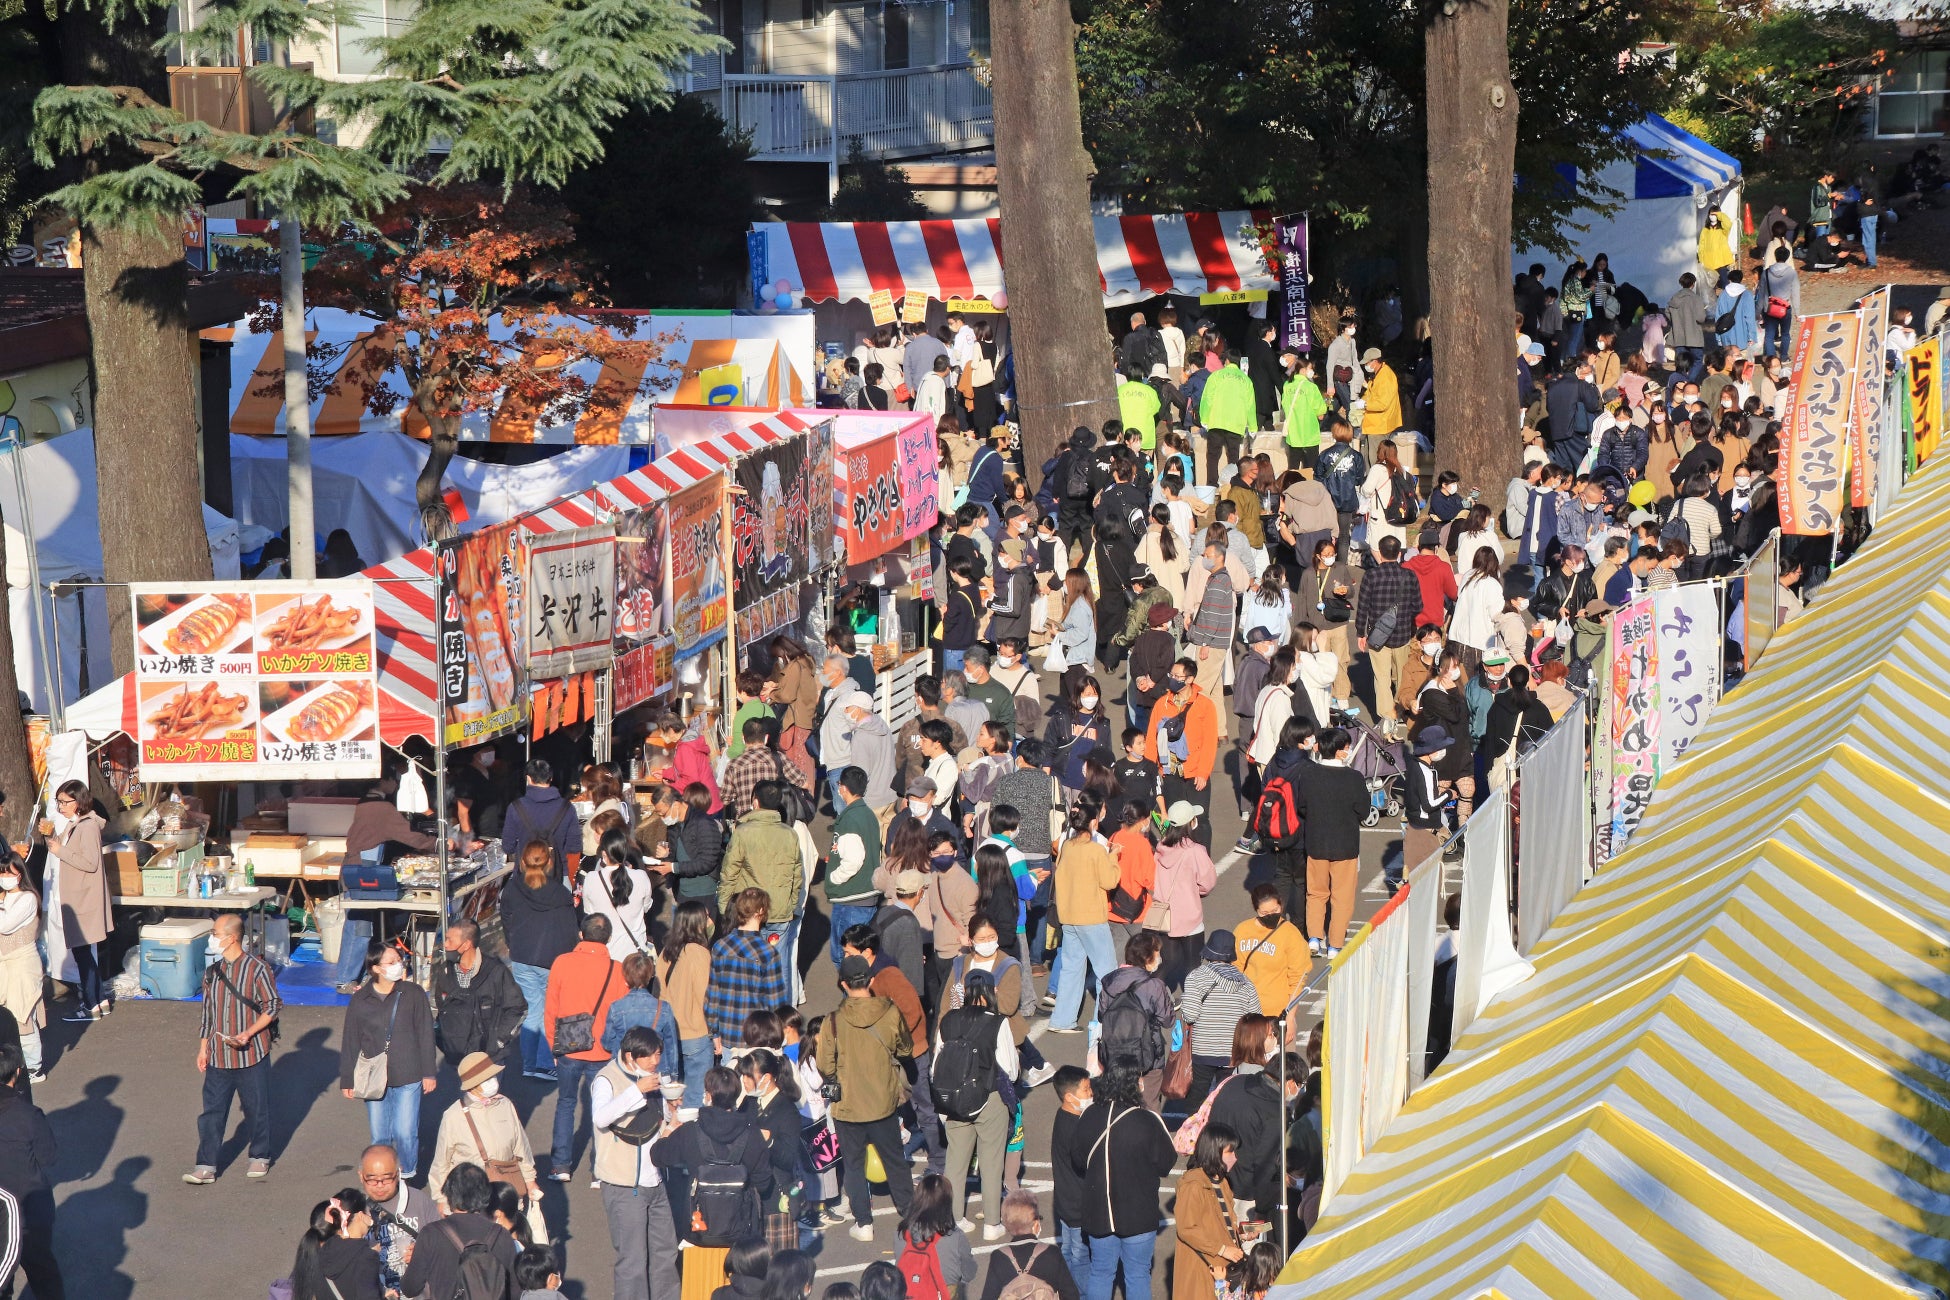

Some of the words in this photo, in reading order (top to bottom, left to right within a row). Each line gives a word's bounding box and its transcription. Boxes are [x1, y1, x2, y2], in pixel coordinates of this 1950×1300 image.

[442, 547, 467, 698] いか焼き
[139, 654, 215, 675] いか焼き
[220, 663, 251, 675] 500円
[260, 653, 370, 673] いかゲソ焼き
[146, 741, 255, 762] いかゲソ焼き
[262, 743, 338, 762] いか焼き
[1240, 938, 1259, 952] GAP
